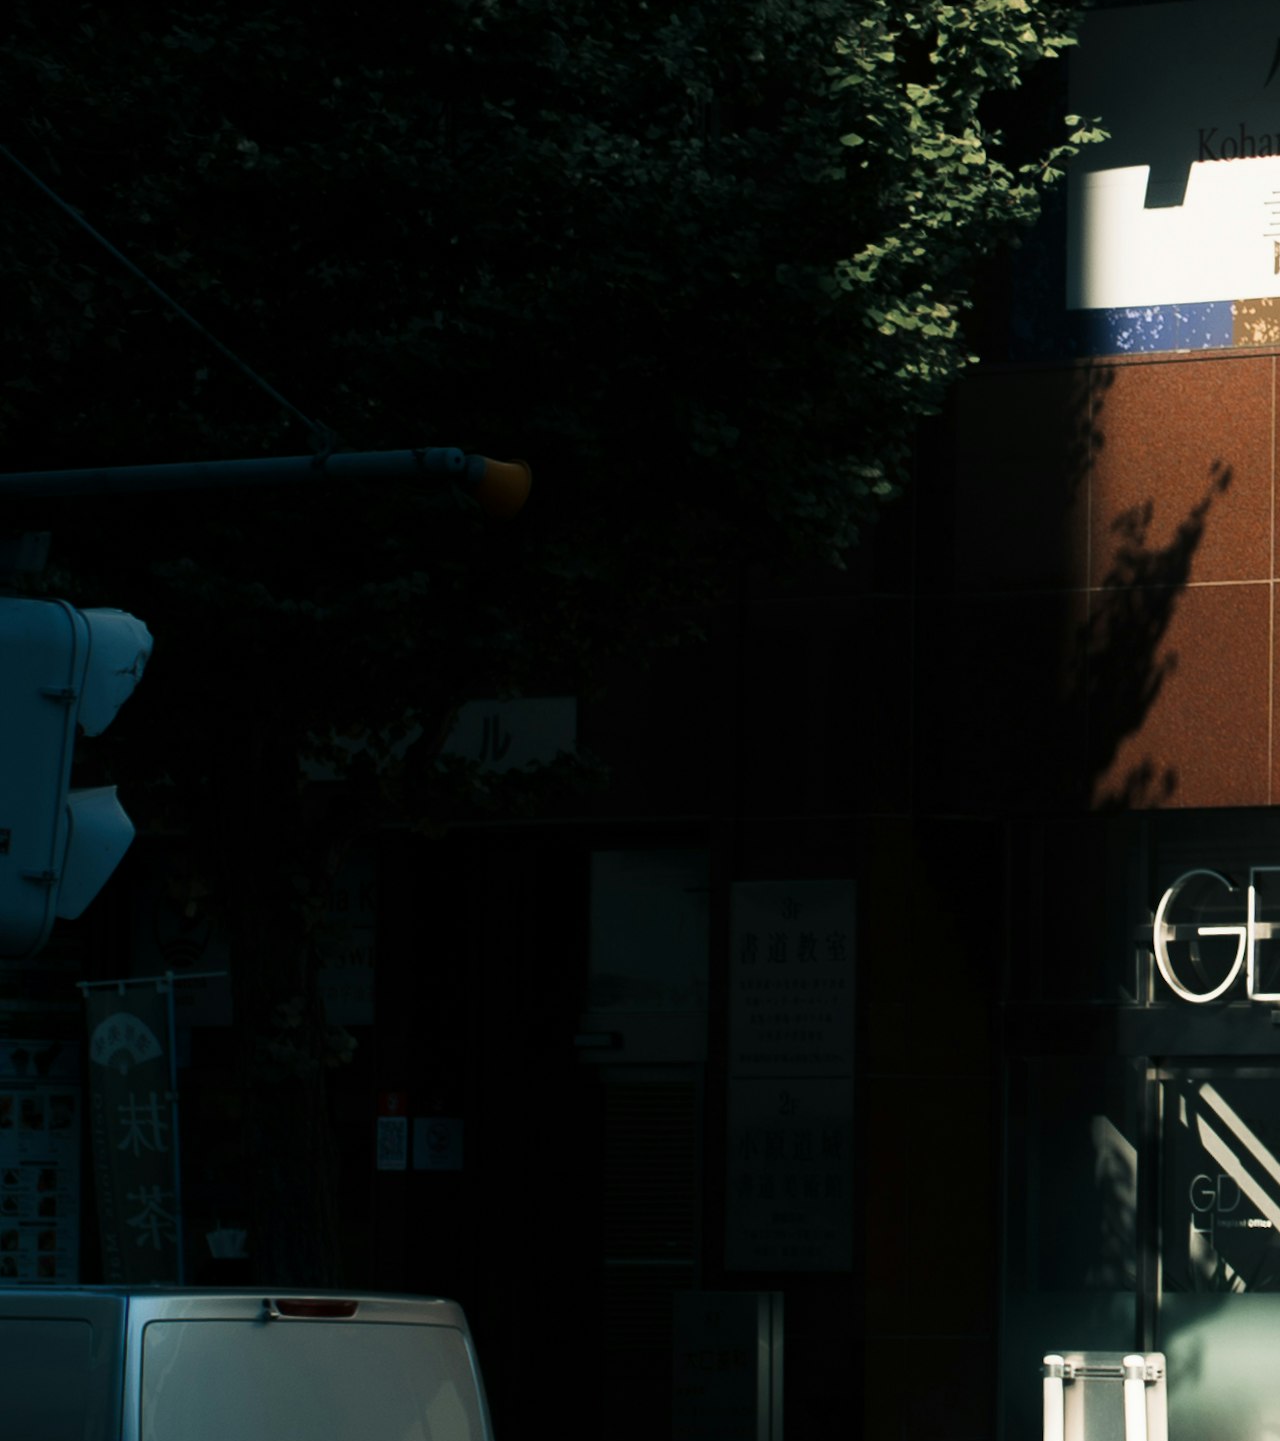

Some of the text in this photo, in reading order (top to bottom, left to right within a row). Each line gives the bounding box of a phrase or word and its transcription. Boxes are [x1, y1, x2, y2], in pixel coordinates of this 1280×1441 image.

[739, 930, 848, 965] 書道教室
[118, 1091, 177, 1251] 抹茶
